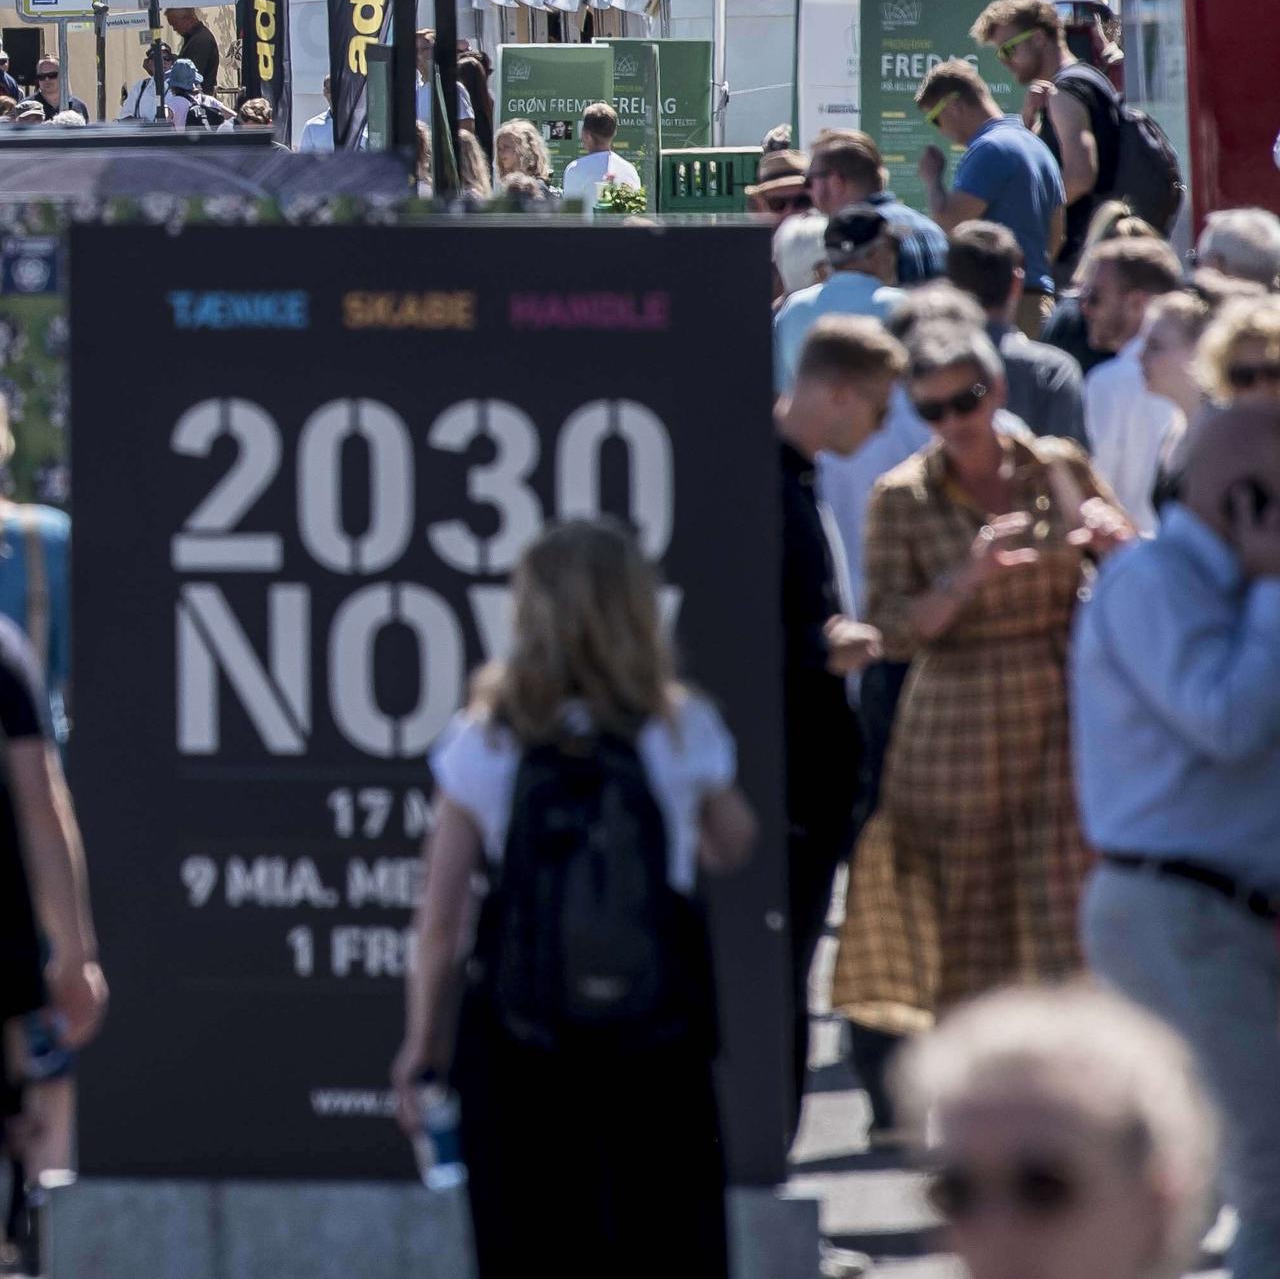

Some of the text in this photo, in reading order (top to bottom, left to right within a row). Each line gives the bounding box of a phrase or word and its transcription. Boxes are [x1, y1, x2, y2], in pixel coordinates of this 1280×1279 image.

[507, 96, 606, 114] GRØN FREMT
[168, 289, 672, 331] TÆNKE SKABE HANDLE
[170, 397, 676, 577] 2030
[327, 787, 393, 839] 17
[179, 855, 221, 909] 9
[226, 859, 339, 909] MIA.
[286, 926, 315, 978] 1
